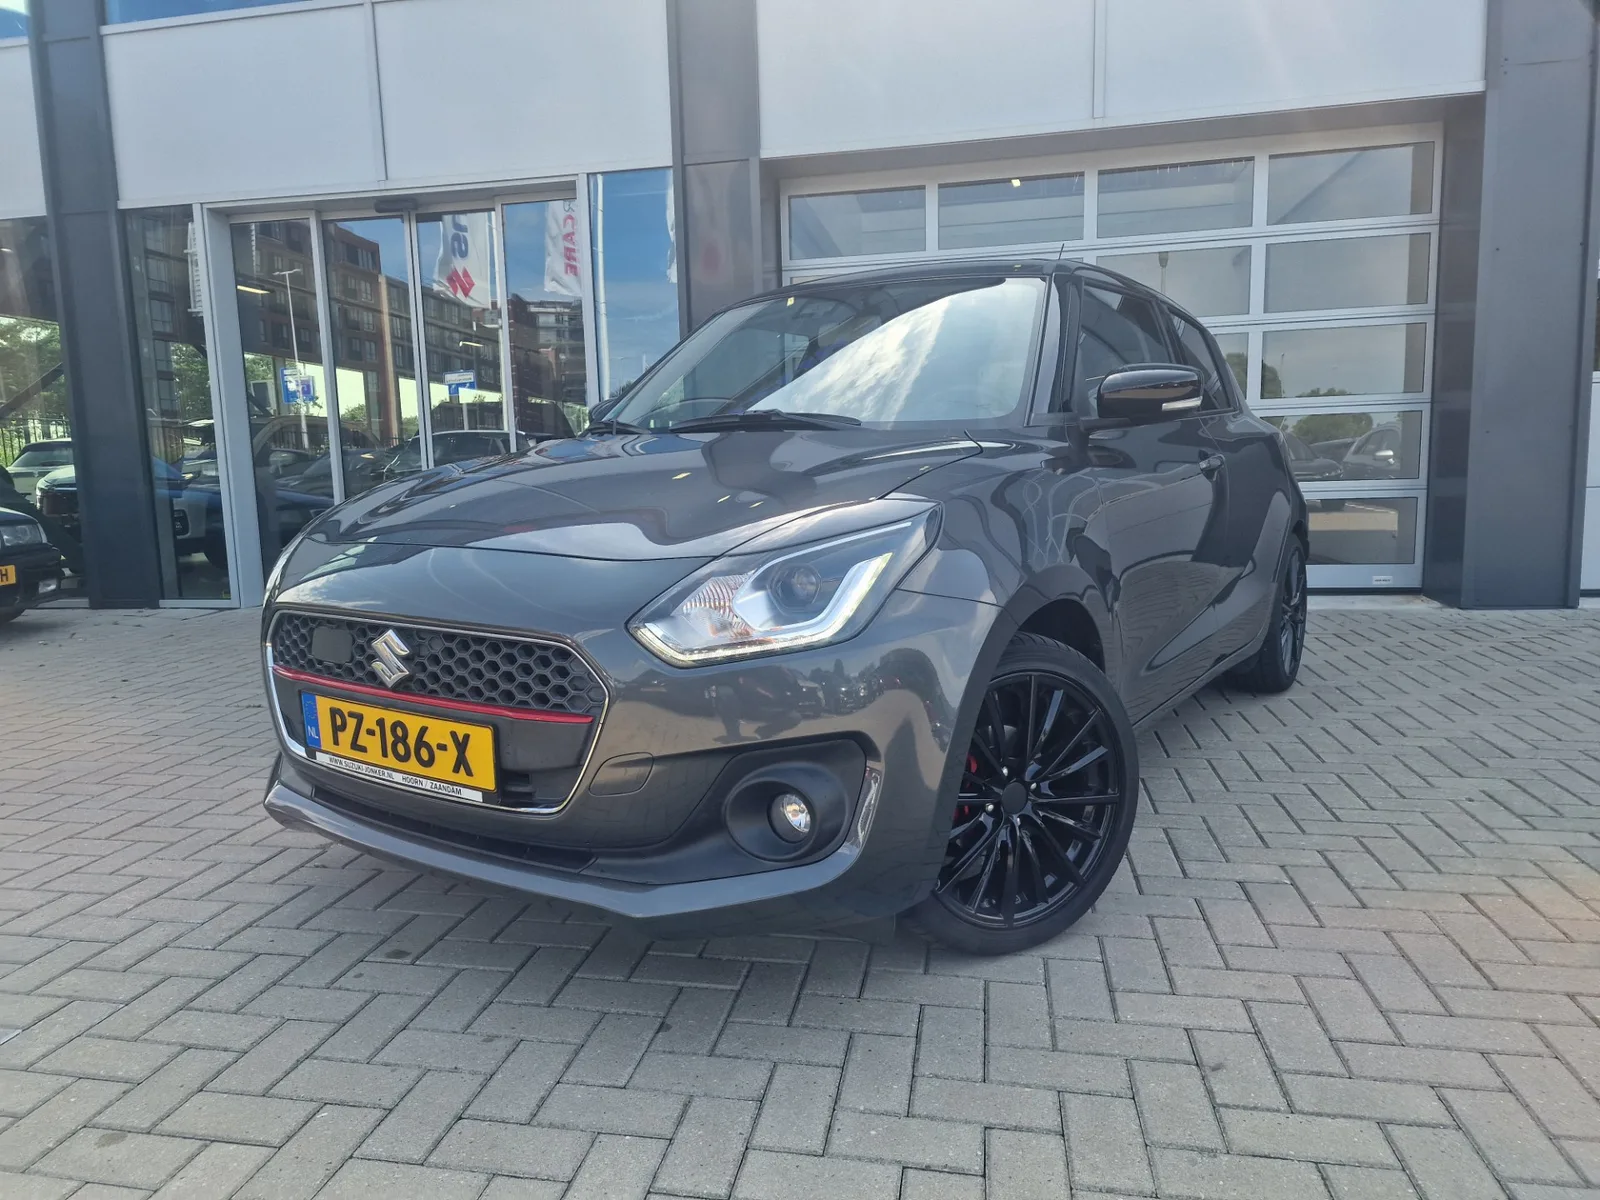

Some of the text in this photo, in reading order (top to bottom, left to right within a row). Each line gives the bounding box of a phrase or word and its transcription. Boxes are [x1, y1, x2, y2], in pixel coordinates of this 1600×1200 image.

[308, 725, 319, 739] NL
[329, 706, 474, 777] PZ-186-X
[329, 756, 395, 780] WWW.SUZUKI-JONKER.NL
[401, 775, 424, 787] HOORN
[430, 781, 462, 796] ZAANDAM
